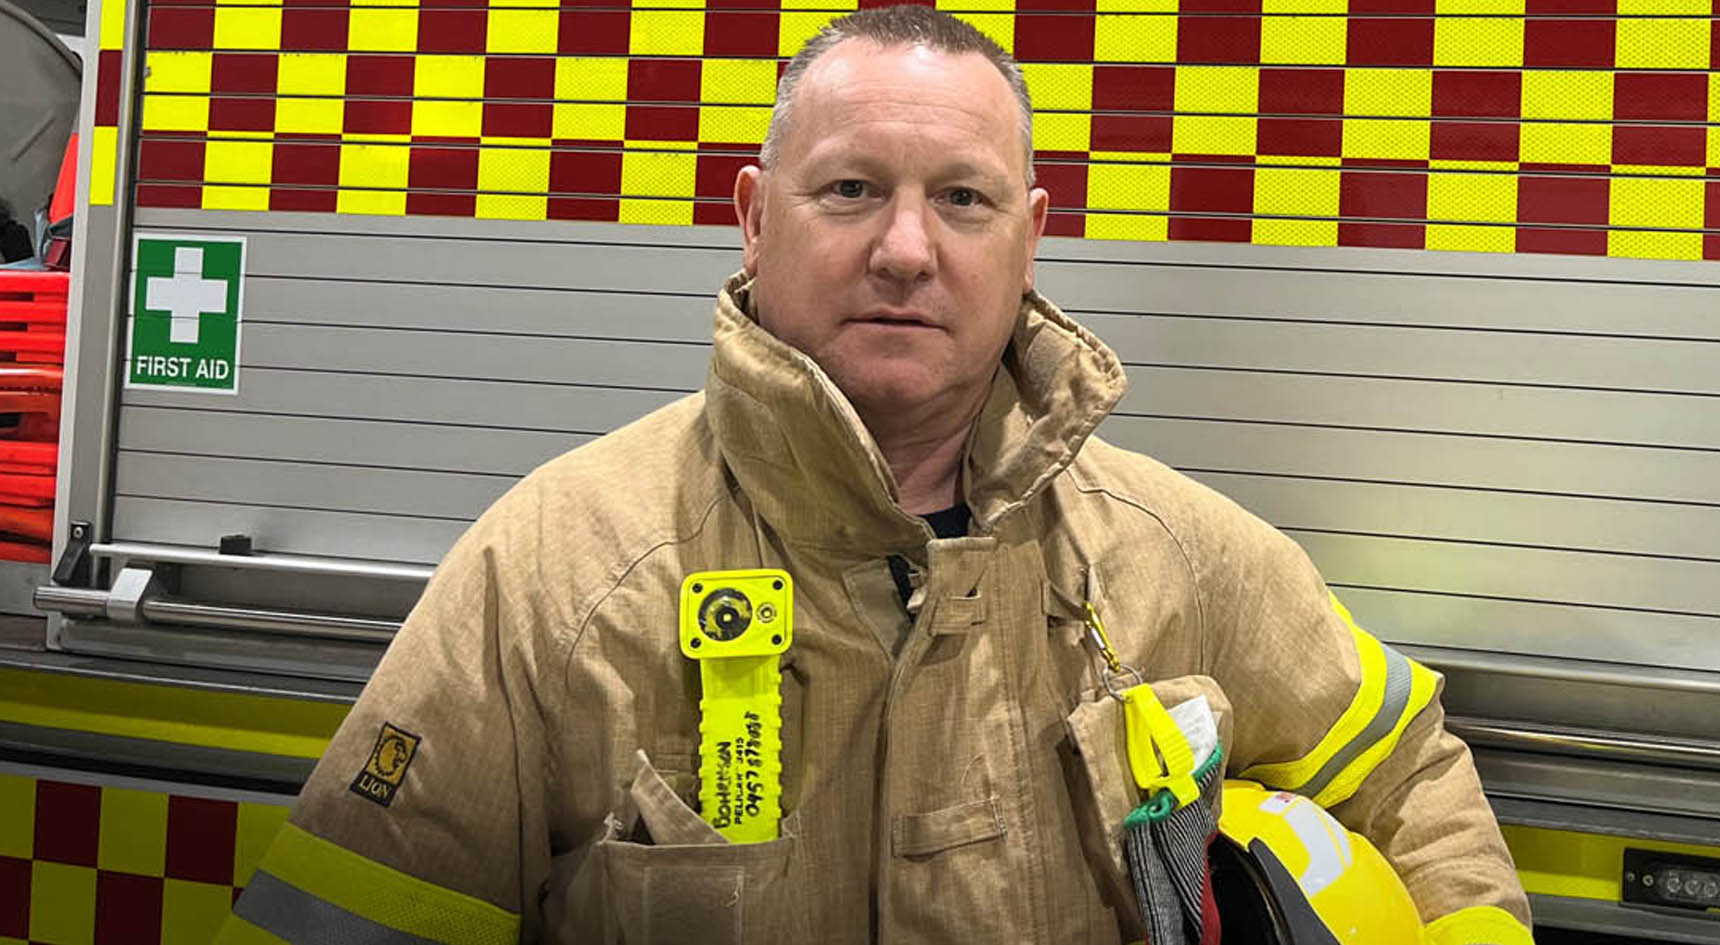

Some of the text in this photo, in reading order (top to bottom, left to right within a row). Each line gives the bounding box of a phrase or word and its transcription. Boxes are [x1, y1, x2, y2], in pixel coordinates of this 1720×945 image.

[136, 355, 229, 380] FIRST AID
[359, 773, 389, 799] LION
